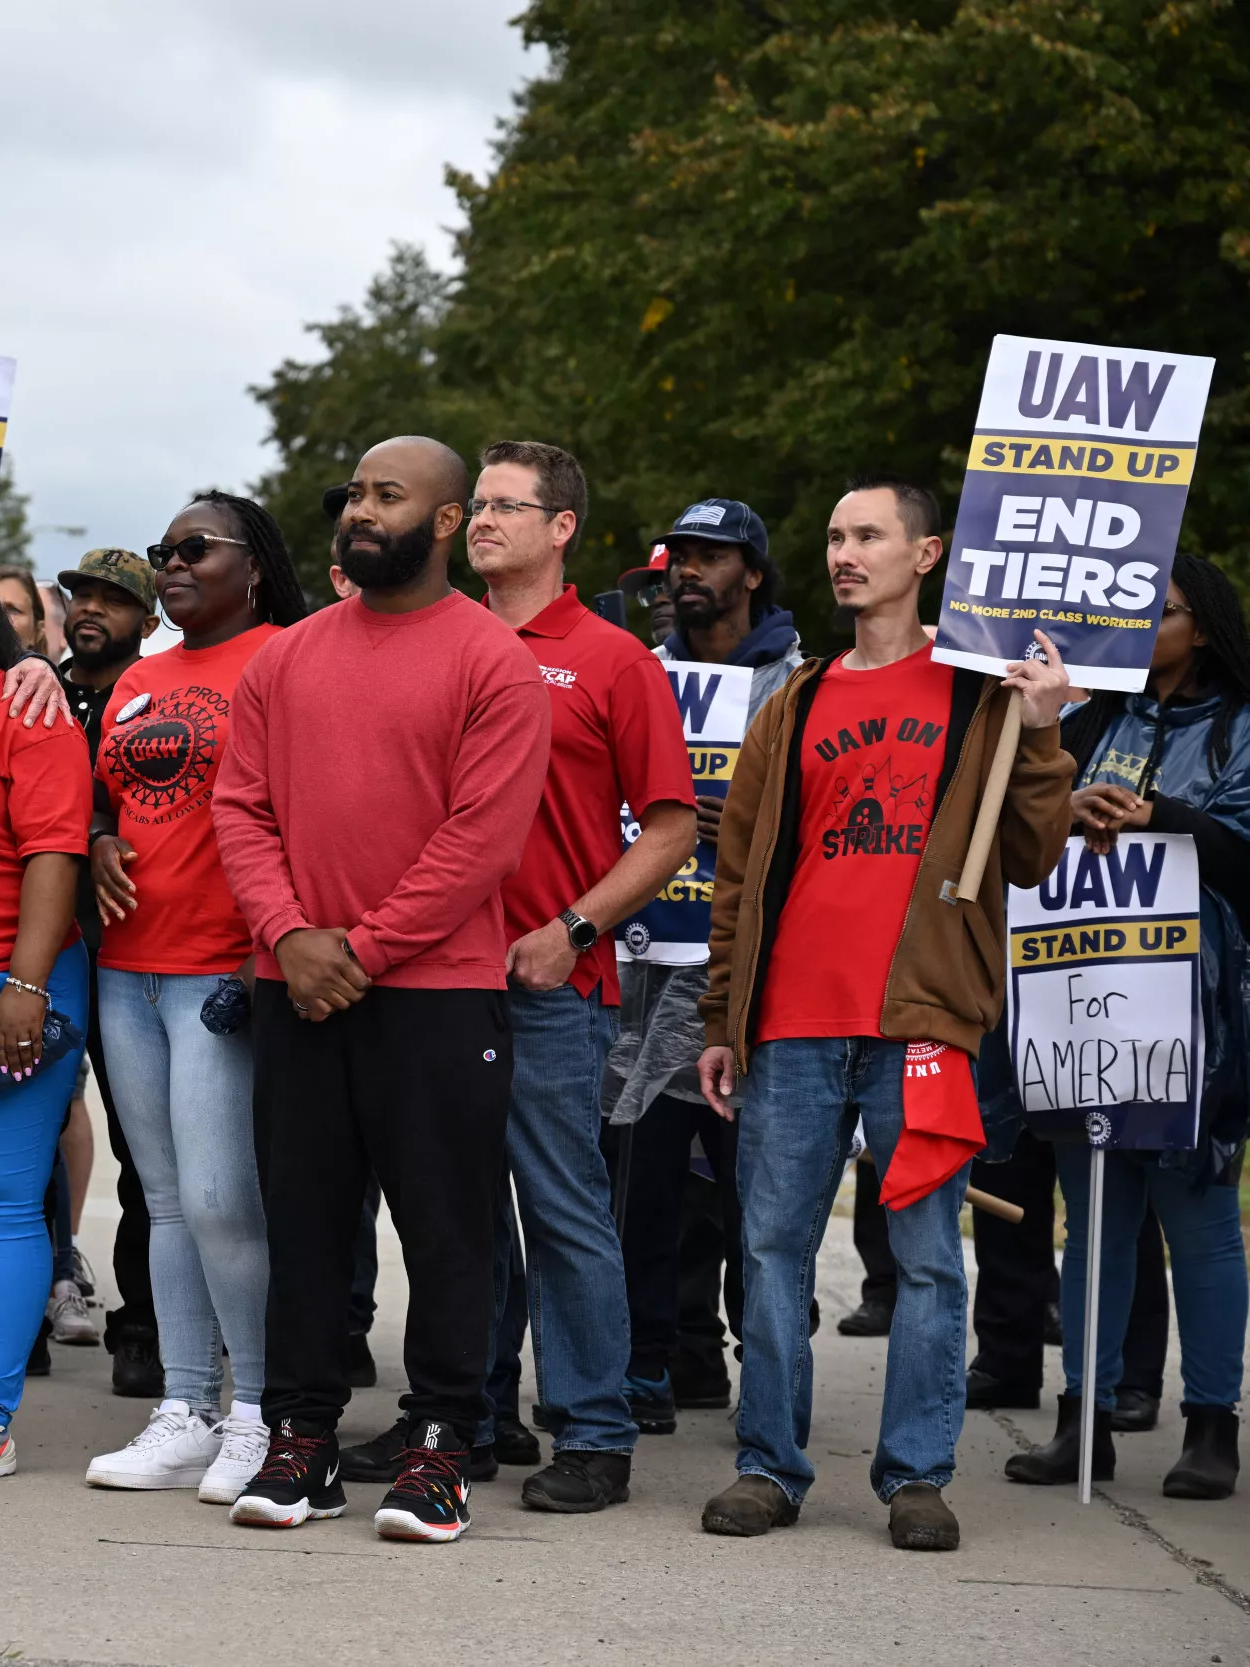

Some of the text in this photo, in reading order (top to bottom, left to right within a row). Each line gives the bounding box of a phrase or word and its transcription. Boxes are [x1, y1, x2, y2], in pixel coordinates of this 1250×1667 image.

[1018, 350, 1177, 433] UAW
[981, 441, 1180, 479] STAND UP
[994, 494, 1142, 551] END
[960, 547, 1160, 611] TIERS
[950, 600, 1152, 630] NO MORE 2ND CLASS WORKERS
[129, 734, 184, 762] UAW
[814, 717, 945, 763] UAW ON
[688, 752, 728, 775] UP
[125, 789, 213, 825] SCABS ALLOWED
[821, 823, 923, 861] STRIKE
[1038, 842, 1167, 912] UAW
[1021, 926, 1187, 961] STAND UP
[1067, 973, 1128, 1025] For
[1022, 1037, 1190, 1110] AMERICA
